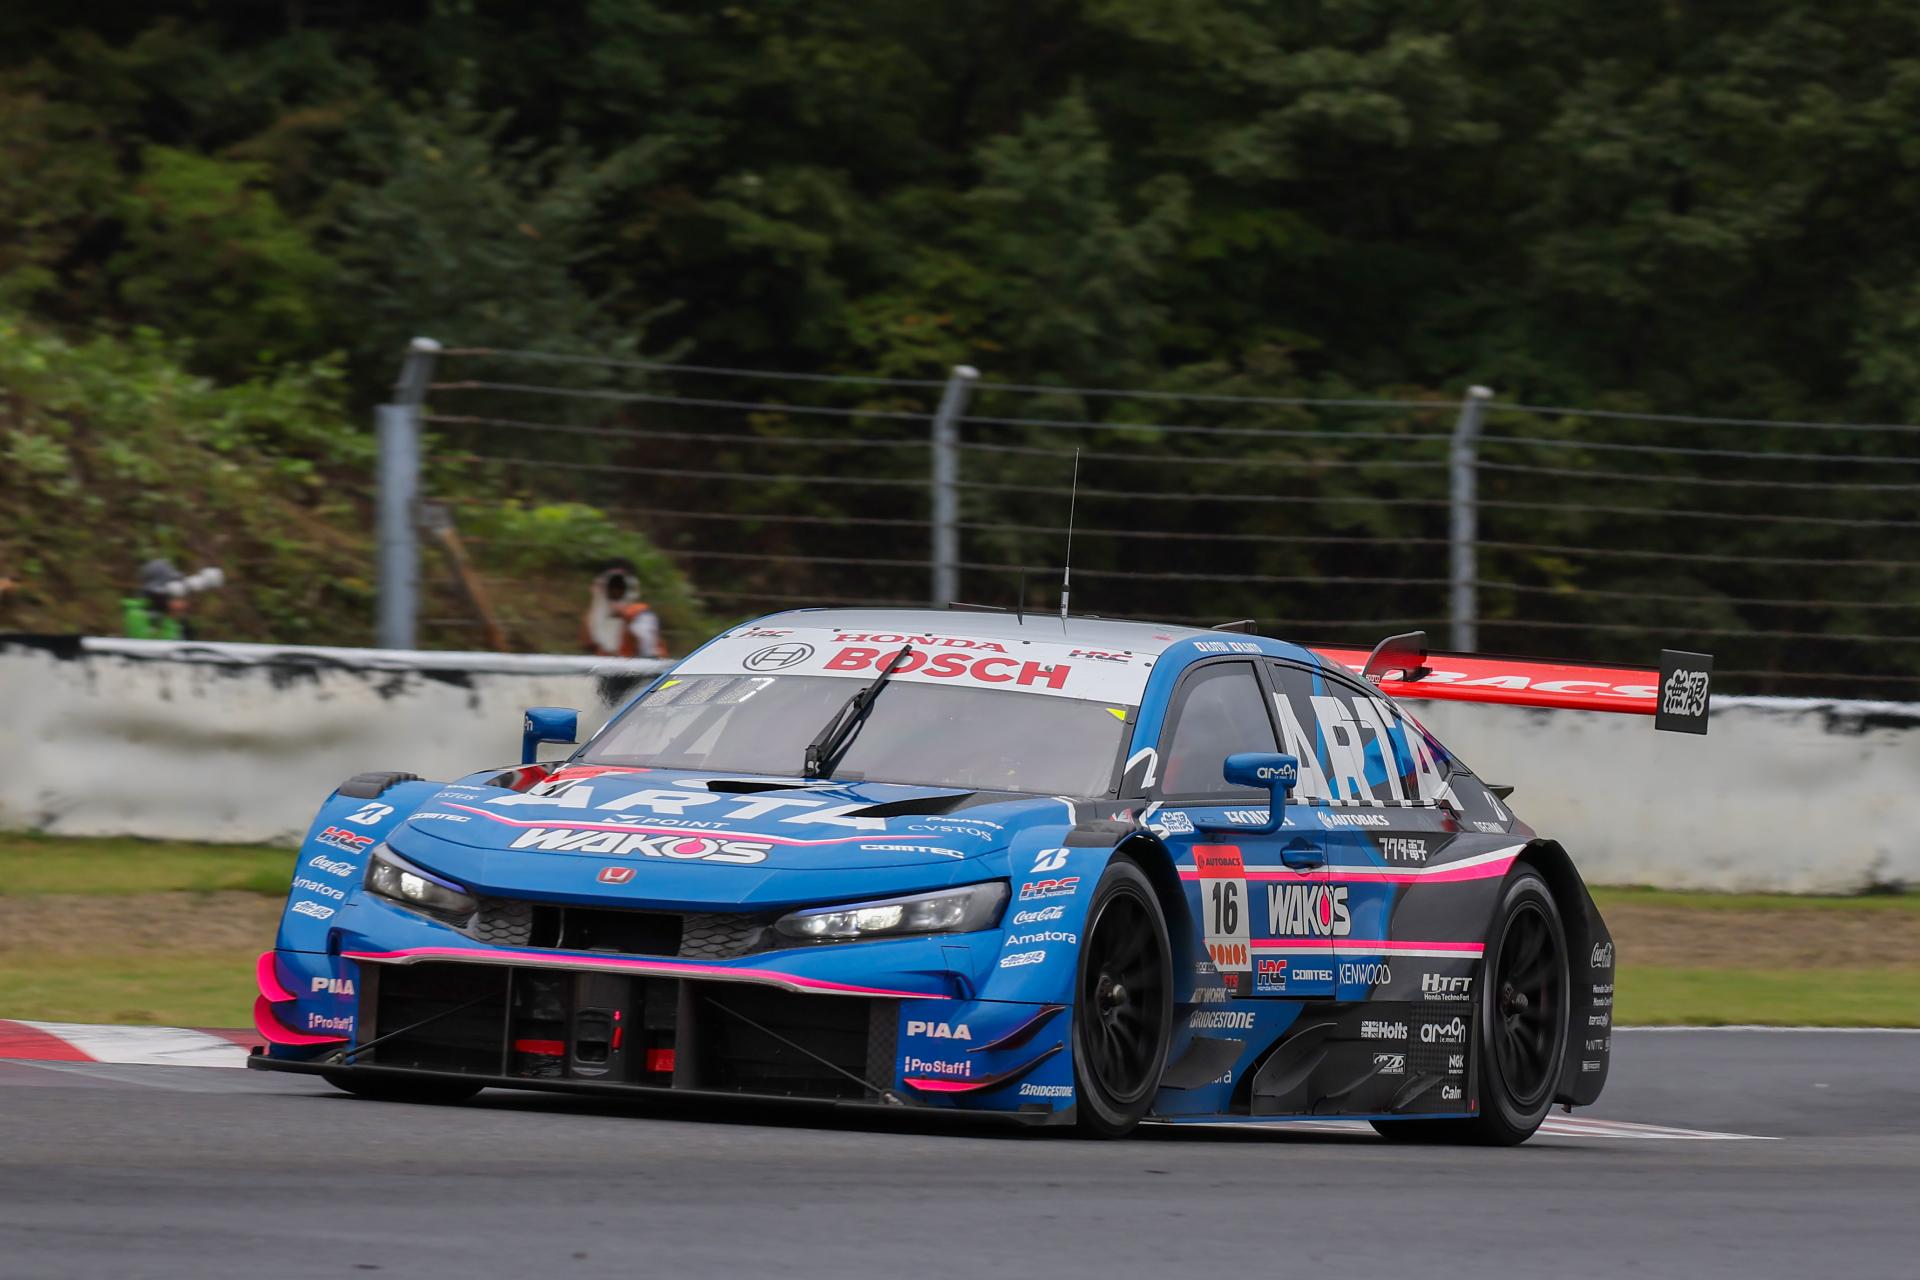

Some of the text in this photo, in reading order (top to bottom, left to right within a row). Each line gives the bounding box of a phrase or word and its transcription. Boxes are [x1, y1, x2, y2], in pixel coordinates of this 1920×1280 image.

[830, 634, 1009, 654] HONDA
[822, 647, 1072, 690] BOSCH
[641, 817, 730, 829] POINT
[1331, 814, 1391, 827] AUTOBACS
[908, 824, 993, 842] CVSTOS
[508, 828, 773, 865] WAKO'S
[859, 843, 966, 860] COMTEC
[1205, 857, 1241, 867] AUTOBACS
[1212, 881, 1238, 935] 16
[1267, 884, 1351, 937] WAKO'S
[1005, 930, 1077, 946] Amatora
[1292, 969, 1333, 980] COMTEC
[1339, 964, 1391, 985] KENWOOD
[311, 977, 354, 995] PIAA
[1189, 1010, 1256, 1028] BRIDGESTONE
[907, 1021, 972, 1040] PIAA
[1380, 1021, 1408, 1039] Holts
[1448, 1055, 1464, 1068] NGK
[1019, 1083, 1073, 1097] BRIDGESTONE
